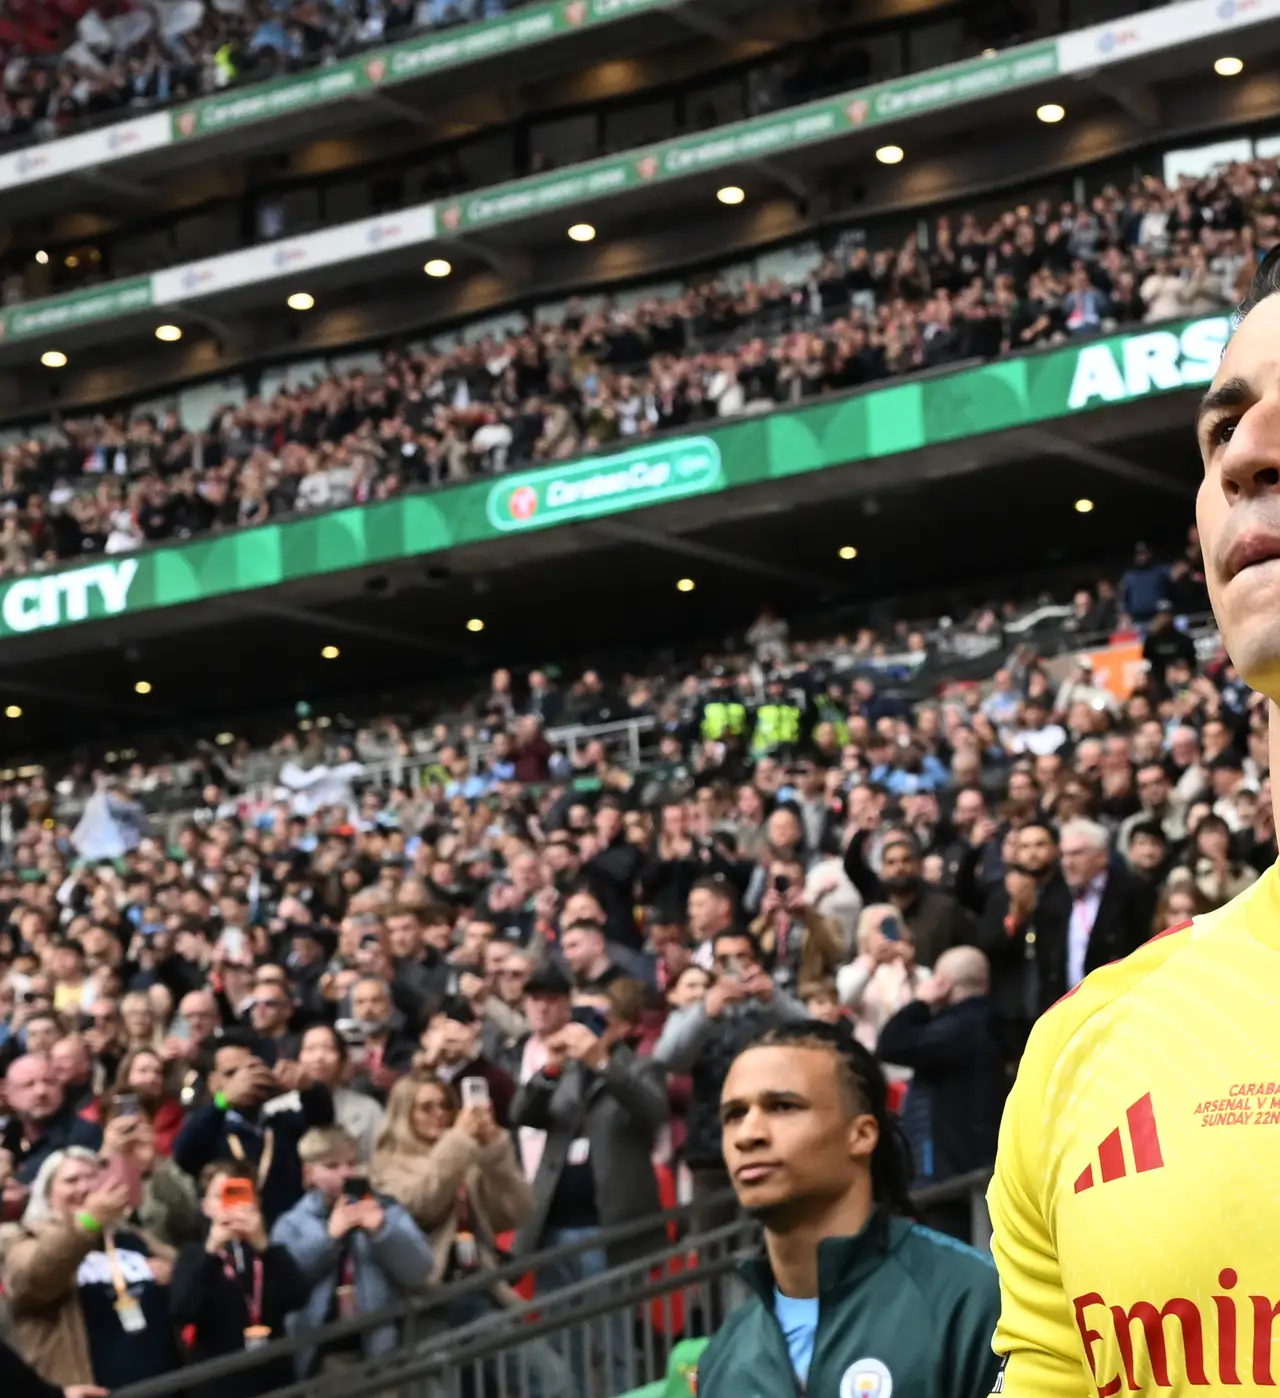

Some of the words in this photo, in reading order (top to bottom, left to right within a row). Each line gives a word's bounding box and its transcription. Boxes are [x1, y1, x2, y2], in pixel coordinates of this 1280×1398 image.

[1067, 315, 1247, 409] ARS
[2, 558, 138, 633] CITY
[1193, 1097, 1252, 1115] ARSENAL
[1256, 1097, 1267, 1109] V
[1200, 1112, 1254, 1128] SUNDAY
